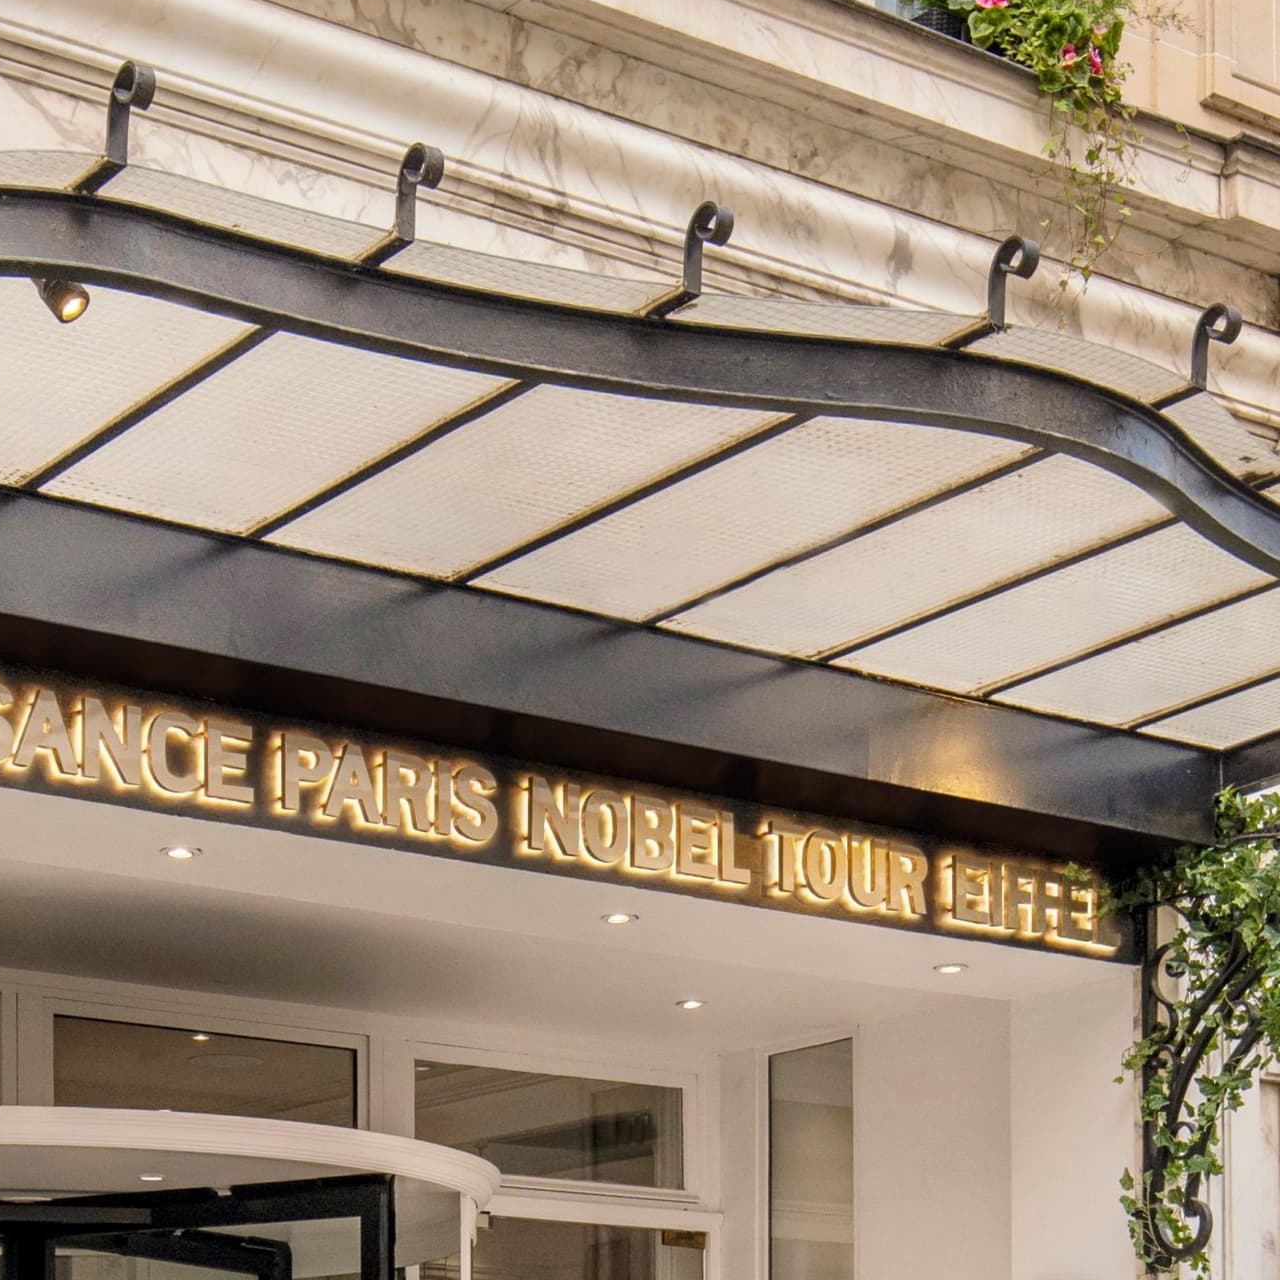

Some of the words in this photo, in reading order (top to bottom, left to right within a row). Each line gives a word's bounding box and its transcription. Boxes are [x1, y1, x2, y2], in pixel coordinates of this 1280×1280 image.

[279, 730, 499, 842] PARIS
[524, 775, 751, 885] NOBEL
[762, 819, 928, 916] TOUR
